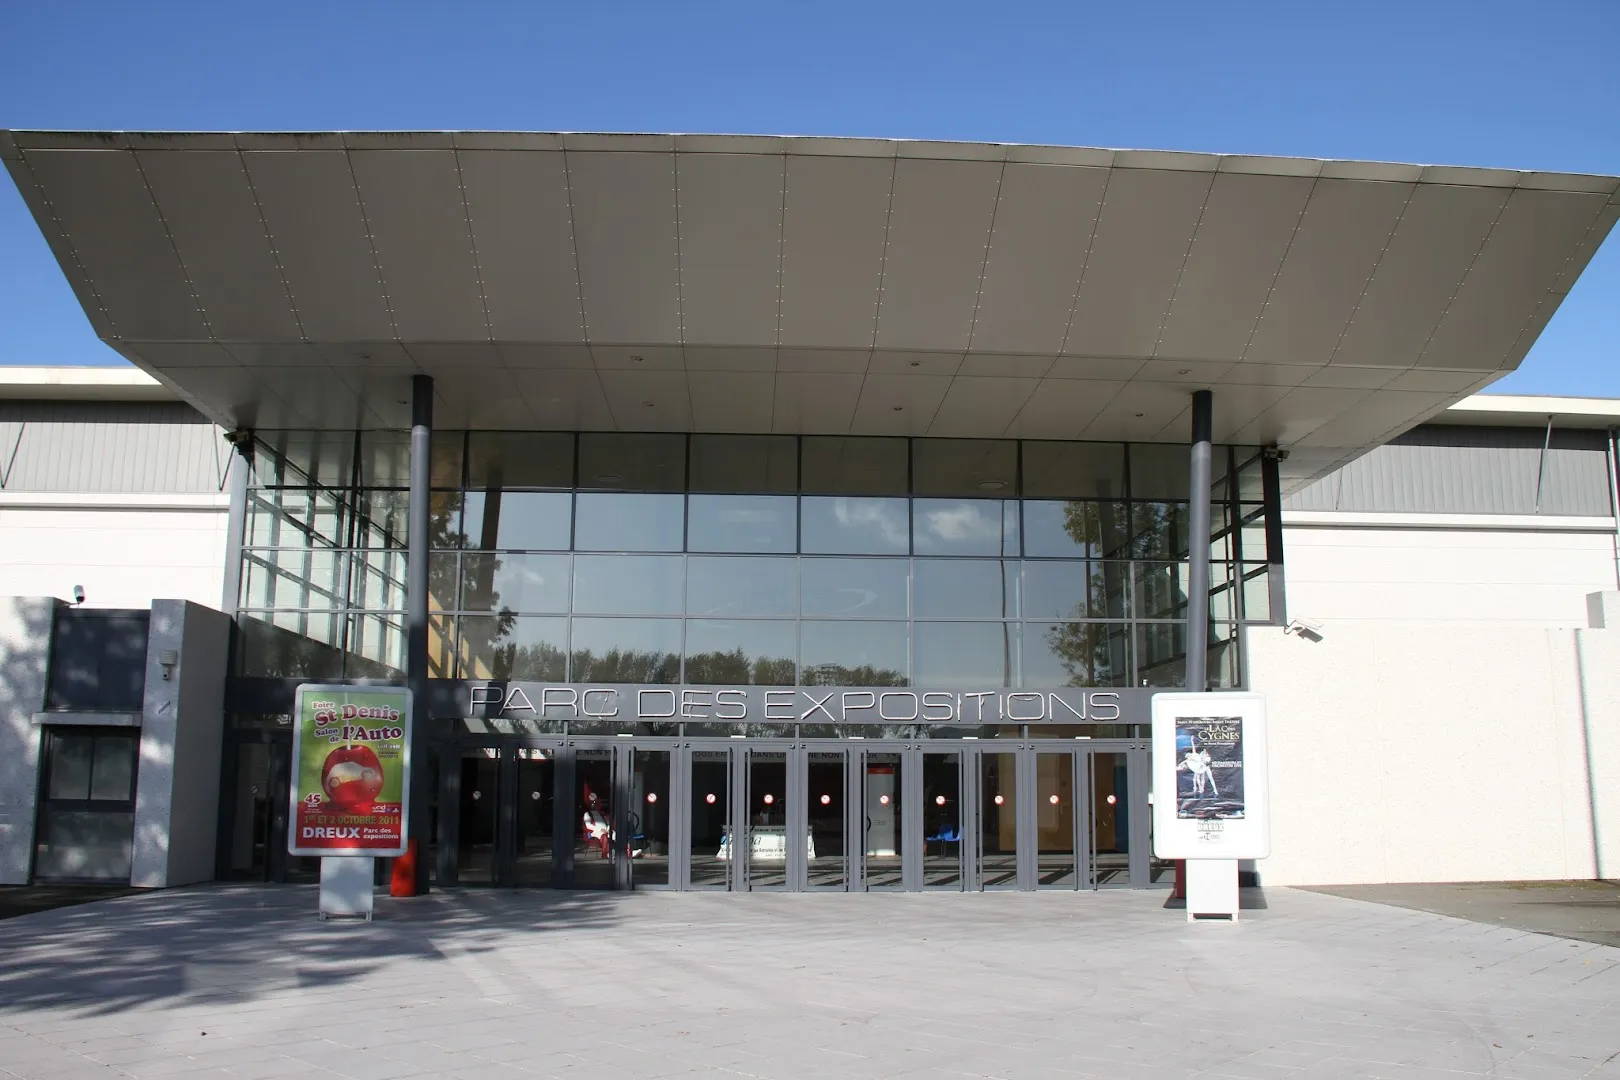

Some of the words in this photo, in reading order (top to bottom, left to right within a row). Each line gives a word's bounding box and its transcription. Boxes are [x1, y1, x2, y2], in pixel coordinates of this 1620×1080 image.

[470, 687, 619, 718] PARC
[638, 690, 748, 719] DES
[765, 690, 1120, 721] EXPOSITIONS
[315, 709, 337, 726] St
[342, 705, 399, 720] Denis
[316, 728, 338, 736] Salon
[342, 726, 402, 740] l'Auto
[1209, 724, 1228, 733] LAC
[1198, 730, 1240, 740] CYGNES
[304, 793, 322, 804] 45
[318, 815, 327, 824] ET
[330, 815, 336, 824] 2
[338, 815, 376, 824] OCTOBRE
[378, 816, 399, 824] 2011
[303, 827, 360, 838] DREUX
